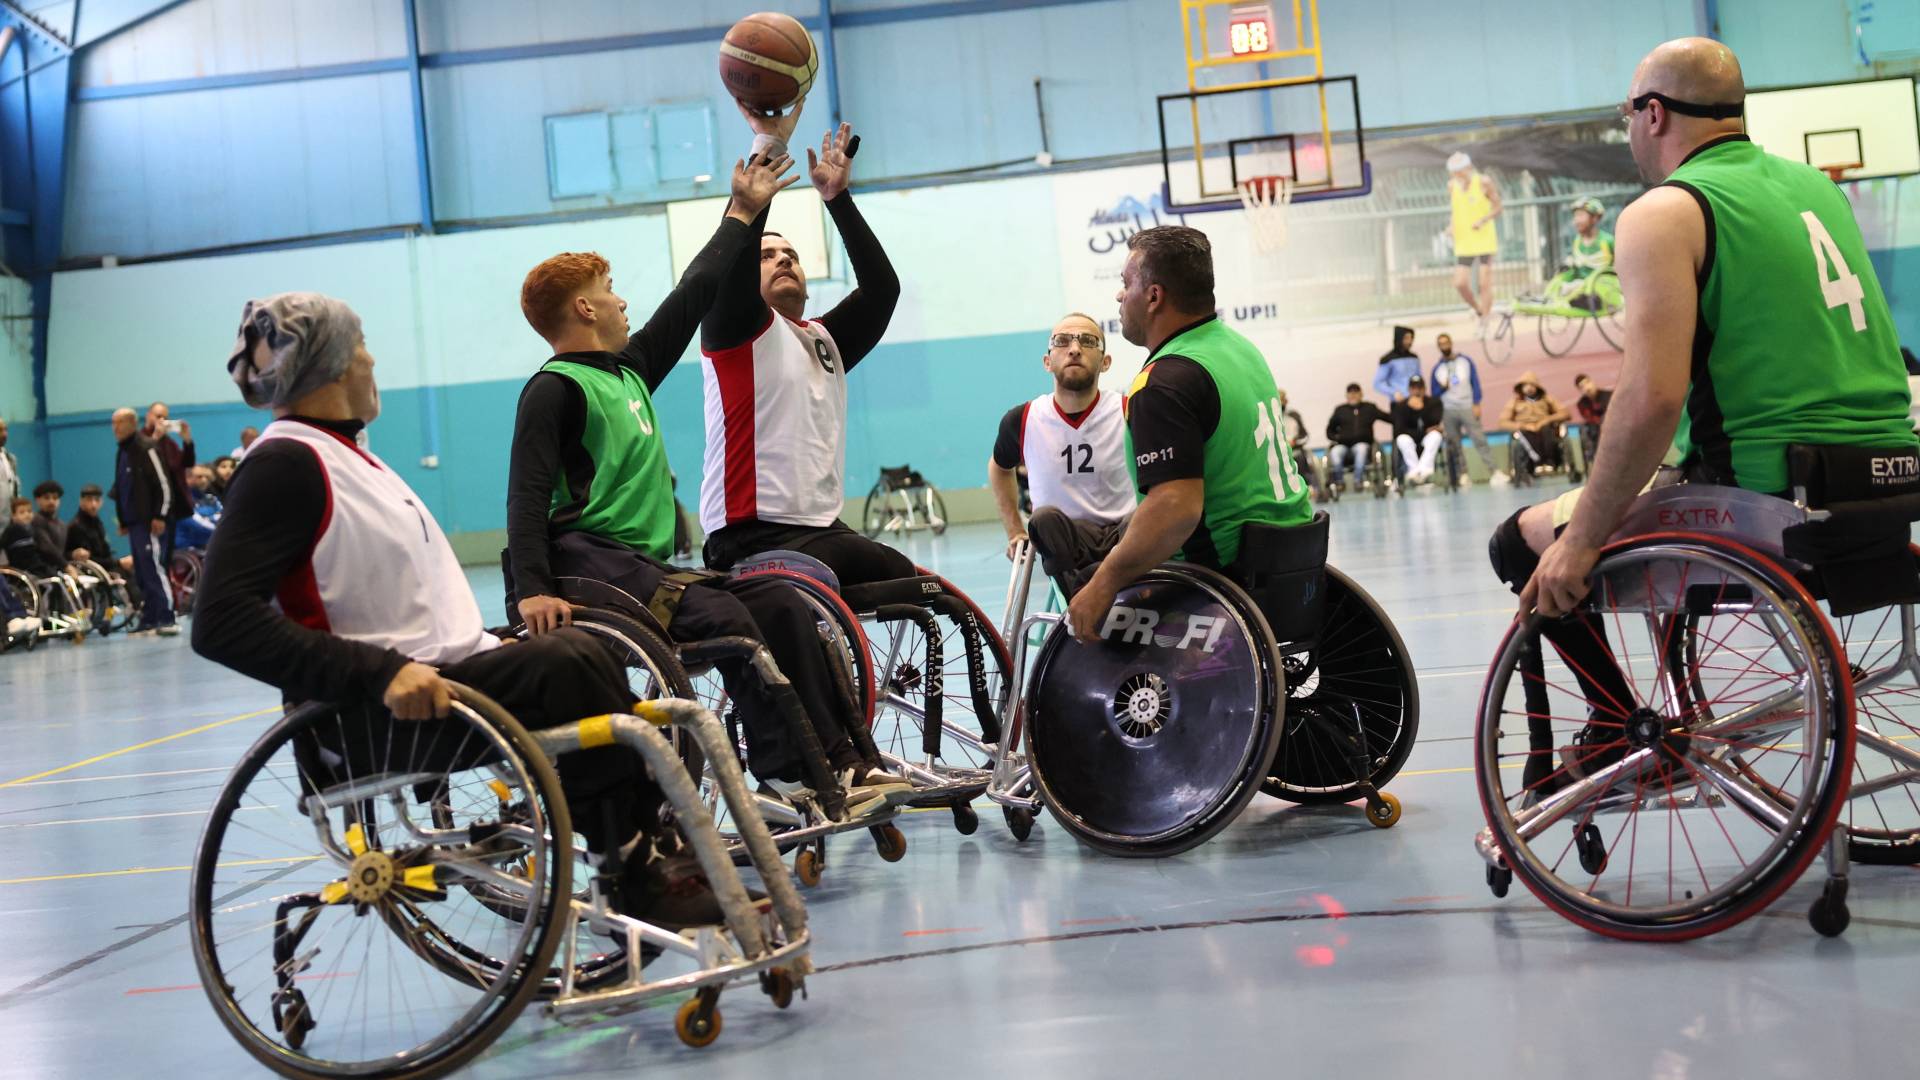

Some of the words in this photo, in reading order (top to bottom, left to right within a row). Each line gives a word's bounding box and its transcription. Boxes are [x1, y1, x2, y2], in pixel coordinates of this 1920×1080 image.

[1800, 210, 1867, 332] 4
[1234, 303, 1277, 321] UP!!
[1060, 443, 1095, 474] 12
[1136, 451, 1159, 467] TOP
[1160, 446, 1175, 460] 11
[1871, 455, 1920, 477] EXTRA
[1658, 507, 1735, 526] EXTRA
[926, 636, 936, 697] WHEELCHAIR
[970, 632, 983, 692] WHEELCHAIR
